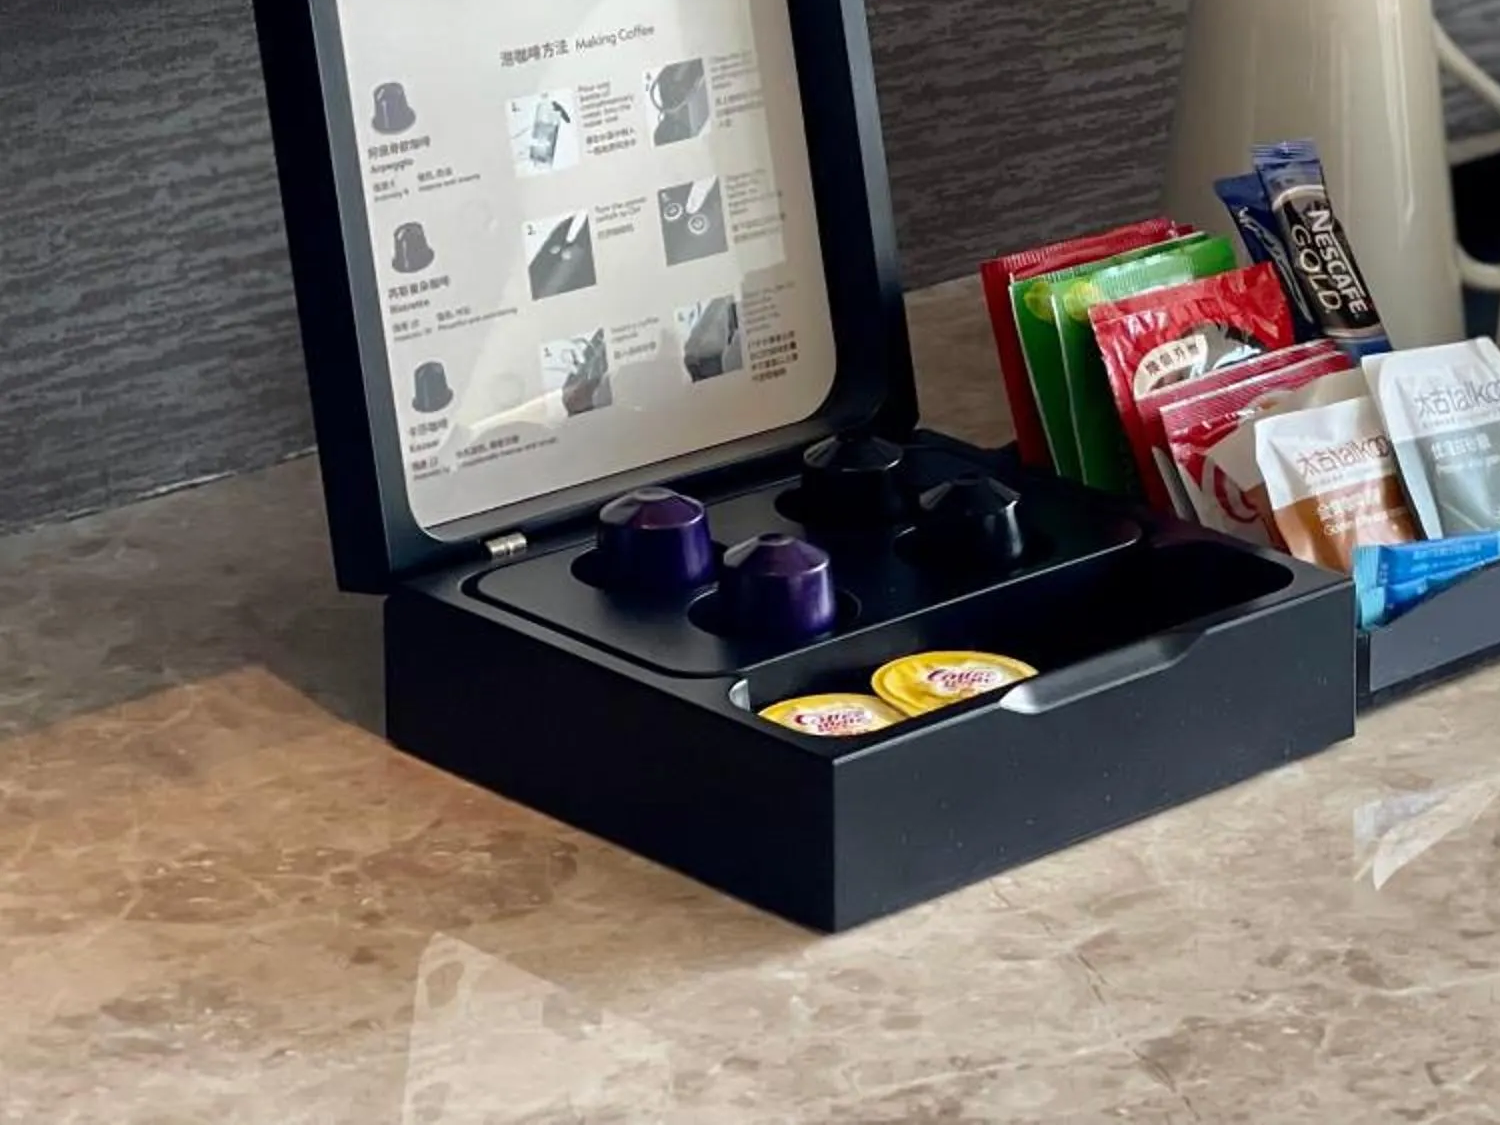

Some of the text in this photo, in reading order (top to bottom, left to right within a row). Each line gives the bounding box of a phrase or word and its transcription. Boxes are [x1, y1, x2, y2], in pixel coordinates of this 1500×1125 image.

[575, 33, 617, 51] Making
[618, 24, 655, 42] Coffee
[1291, 225, 1342, 311] GOLD
